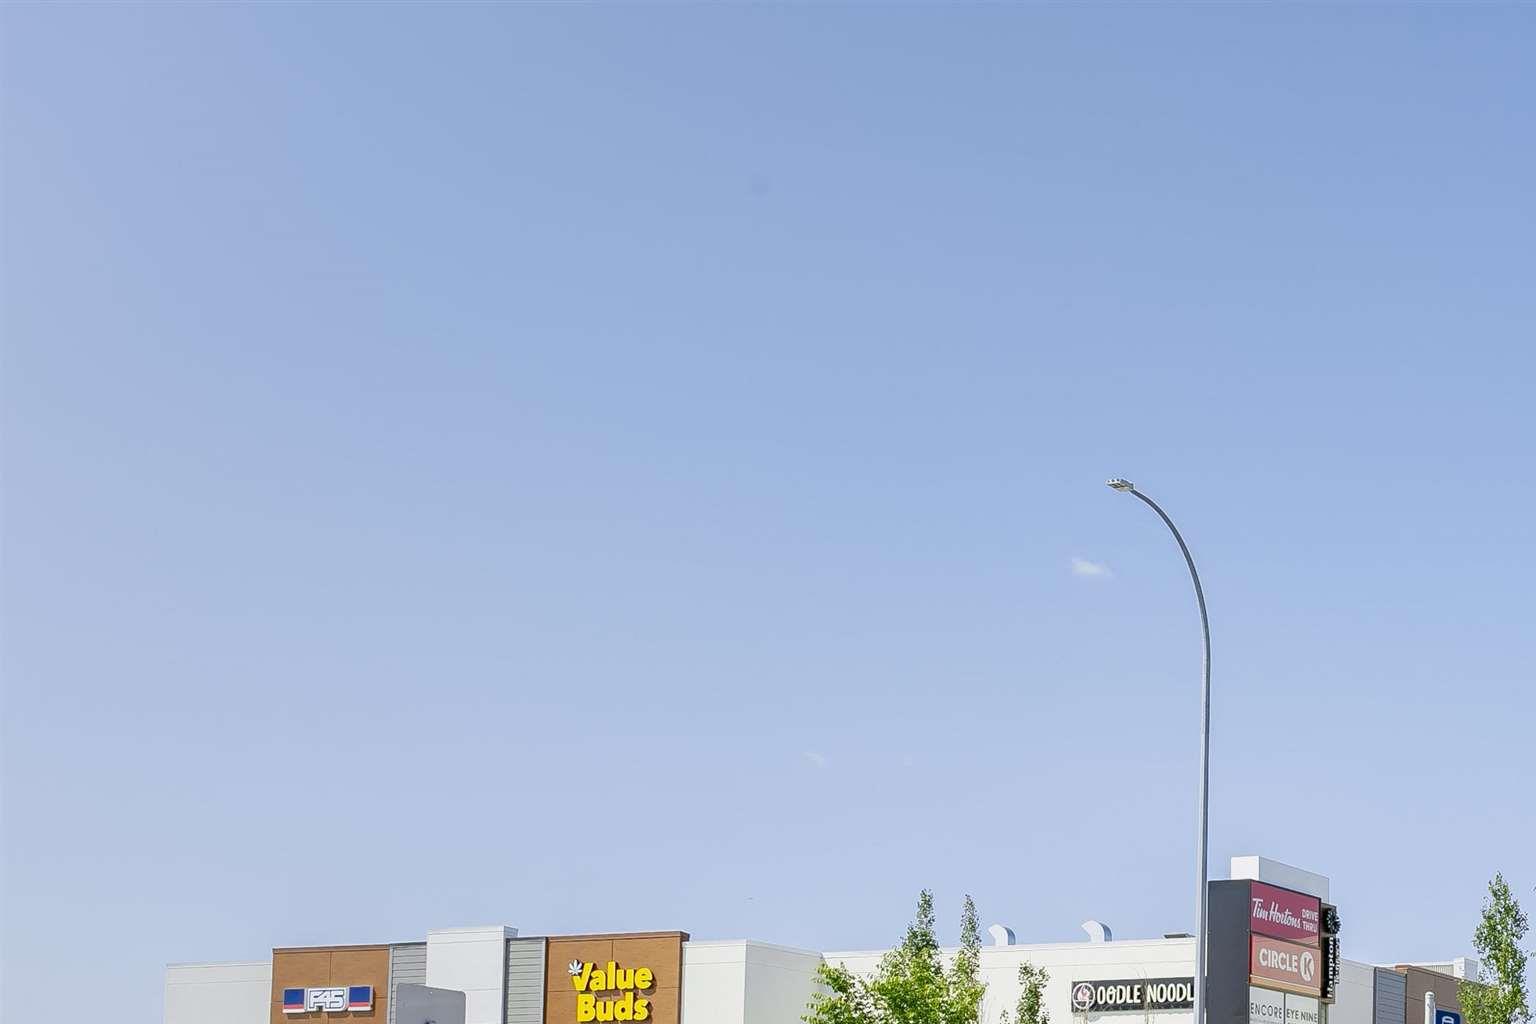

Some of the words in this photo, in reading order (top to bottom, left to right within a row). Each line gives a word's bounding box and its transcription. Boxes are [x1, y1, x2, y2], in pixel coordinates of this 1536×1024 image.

[1252, 898, 1268, 920] Tim
[1268, 901, 1300, 929] Hortons
[1302, 909, 1318, 921] DRIVE
[1303, 921, 1318, 933] THRU
[1259, 948, 1298, 973] CIRCLE
[572, 960, 653, 991] Value
[308, 988, 347, 1012] F45
[1146, 983, 1194, 1003] NOODL
[577, 991, 650, 1022] Buds
[1250, 1002, 1283, 1020] ENCORE
[1286, 1008, 1299, 1020] EYE
[1300, 1011, 1318, 1023] NINE
